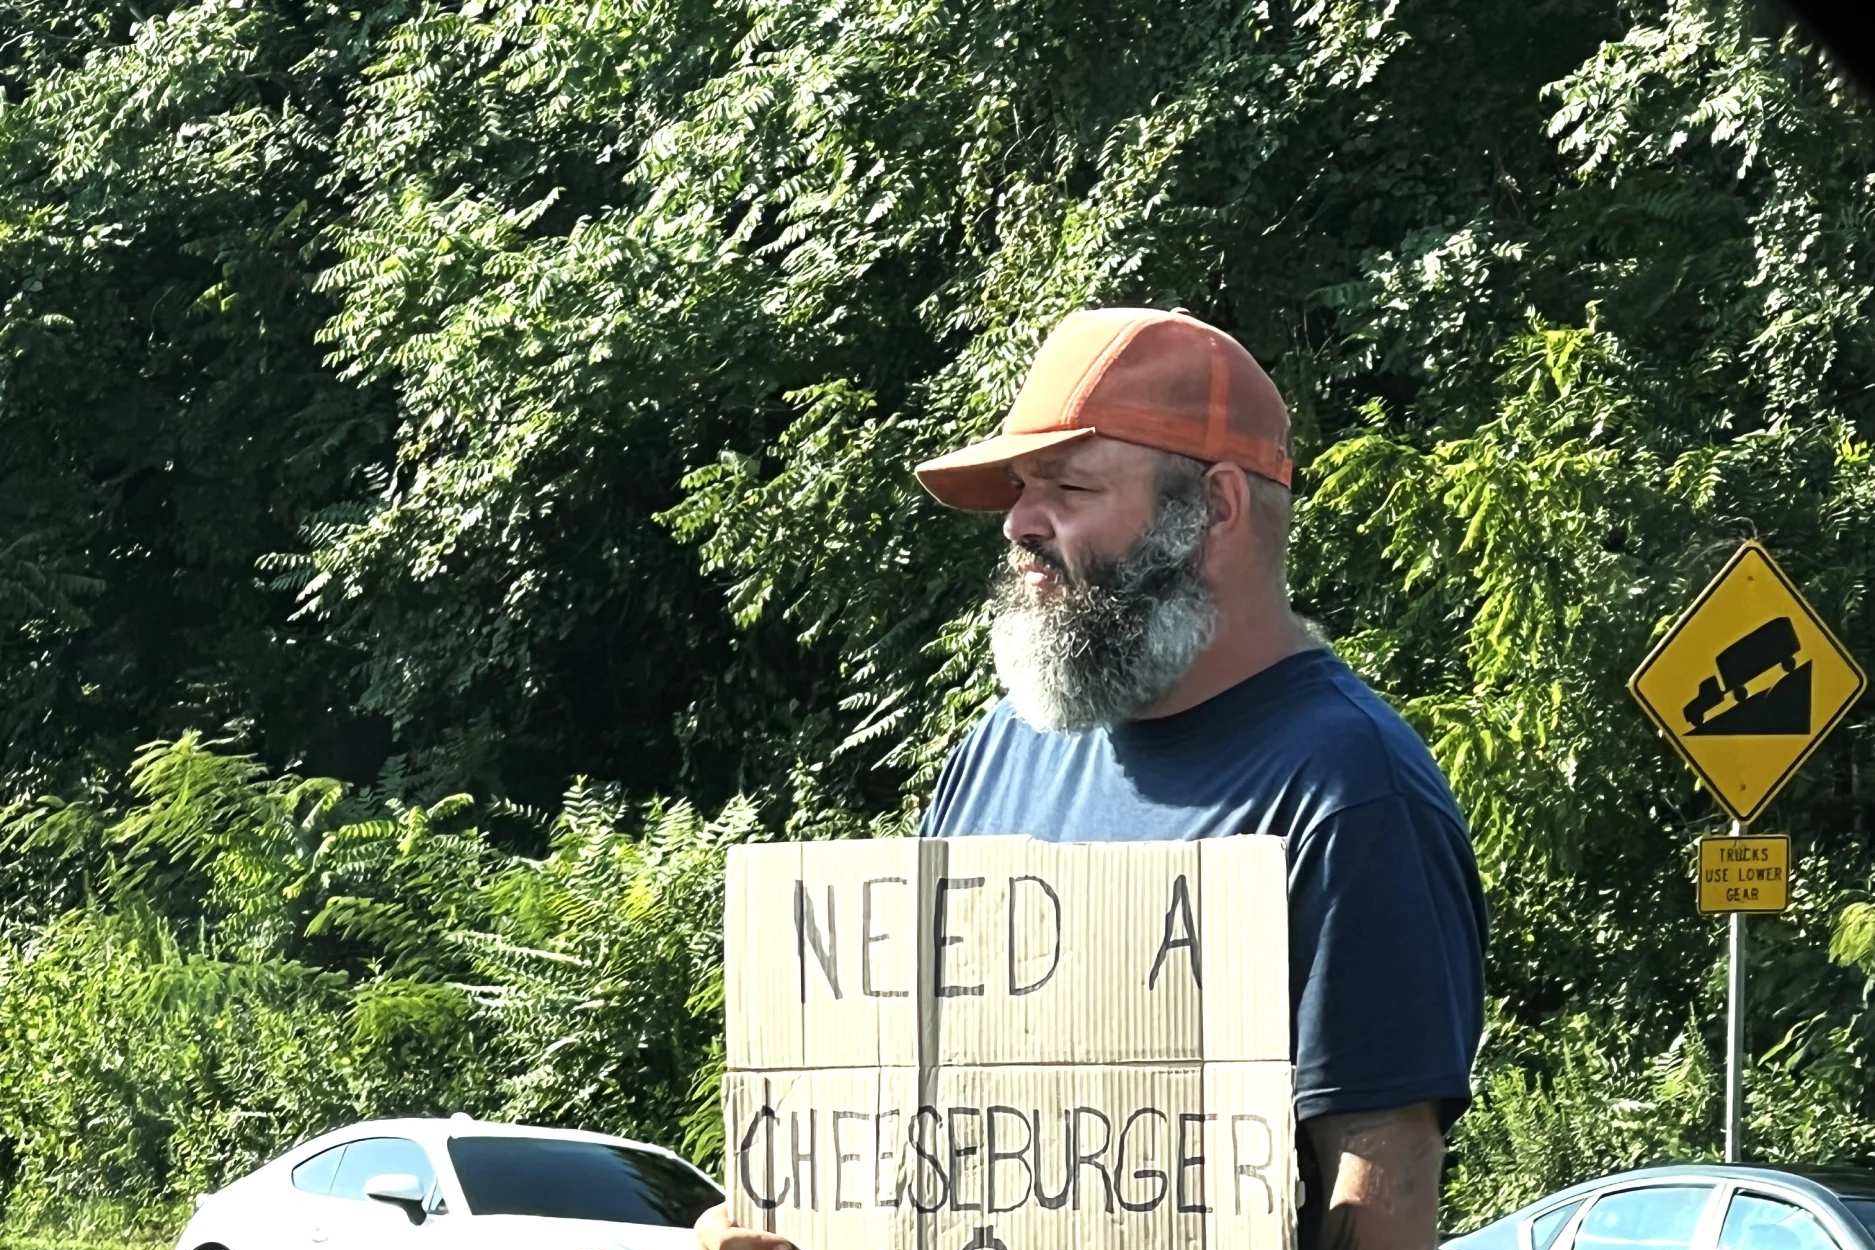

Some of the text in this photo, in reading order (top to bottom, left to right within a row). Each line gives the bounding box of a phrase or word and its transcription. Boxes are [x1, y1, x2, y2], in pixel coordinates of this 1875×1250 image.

[1720, 848, 1769, 862] TRUCKS
[1705, 867, 1783, 883] USE LOWER
[1726, 888, 1760, 902] GEAR
[794, 874, 1202, 1001] NEED A
[740, 1105, 1275, 1215] CHEESEBURGER
